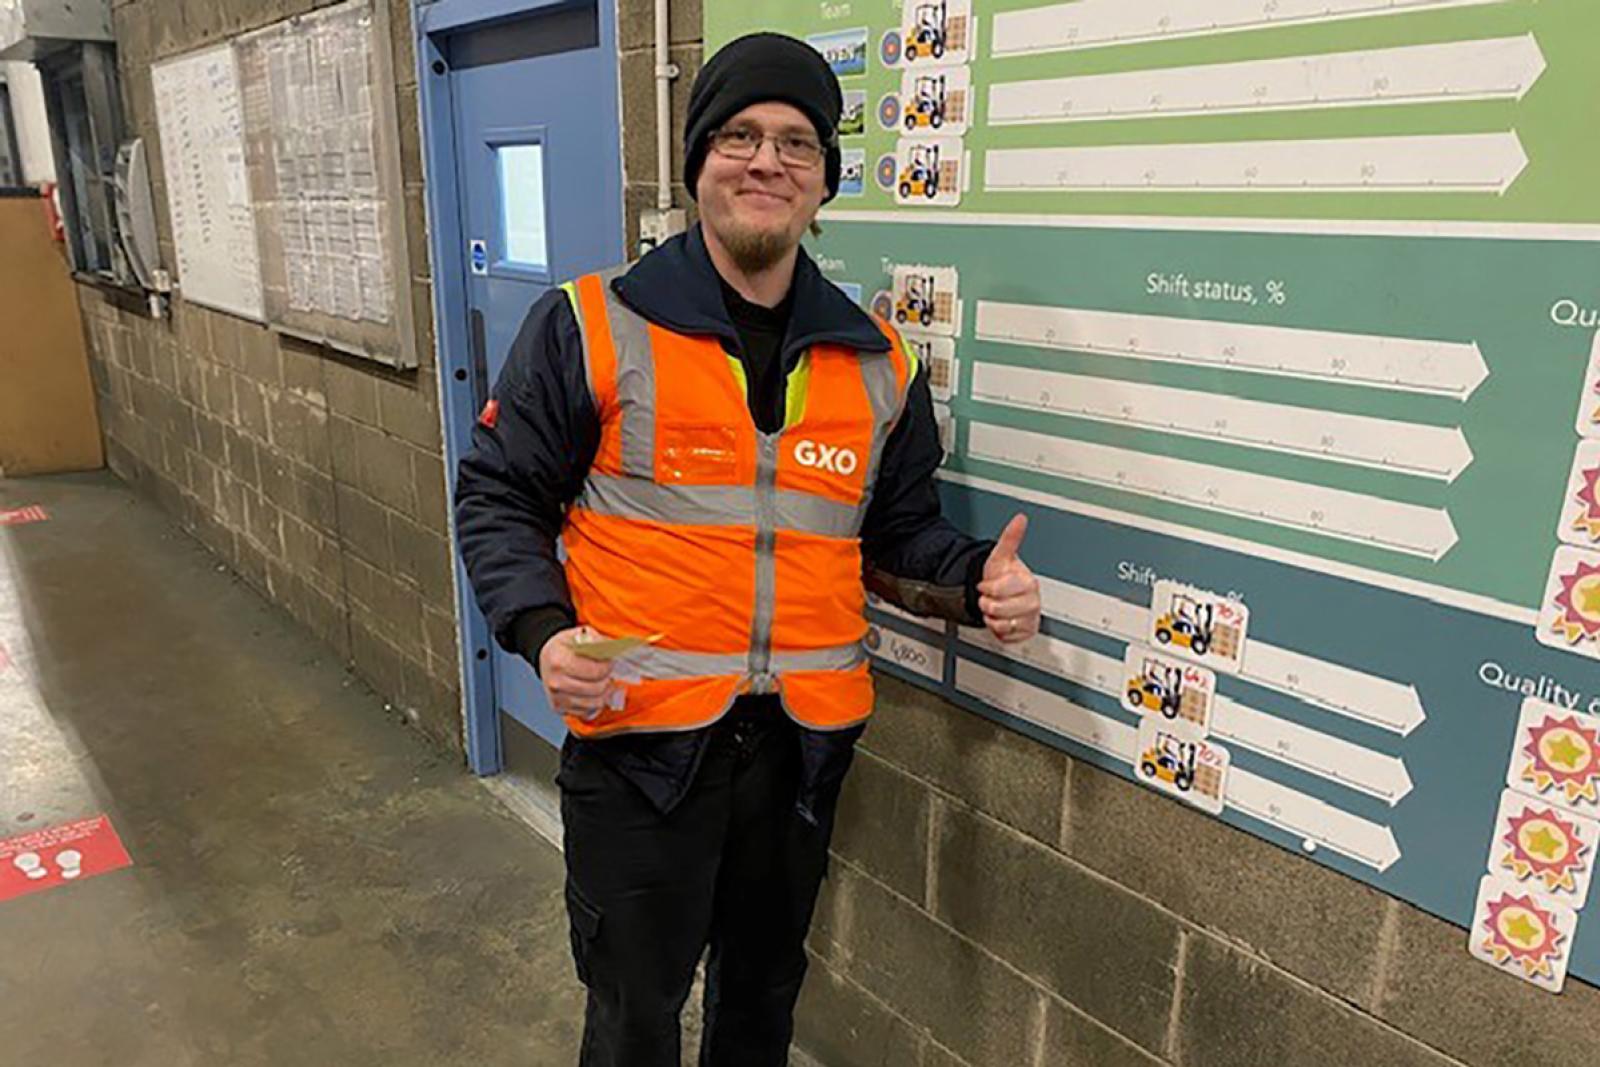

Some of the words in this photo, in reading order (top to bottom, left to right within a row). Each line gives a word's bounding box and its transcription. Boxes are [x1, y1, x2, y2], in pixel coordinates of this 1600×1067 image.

[1146, 272, 1189, 297] Shift
[1193, 279, 1258, 305] status,
[1265, 279, 1286, 305] %
[794, 440, 857, 475] GXO
